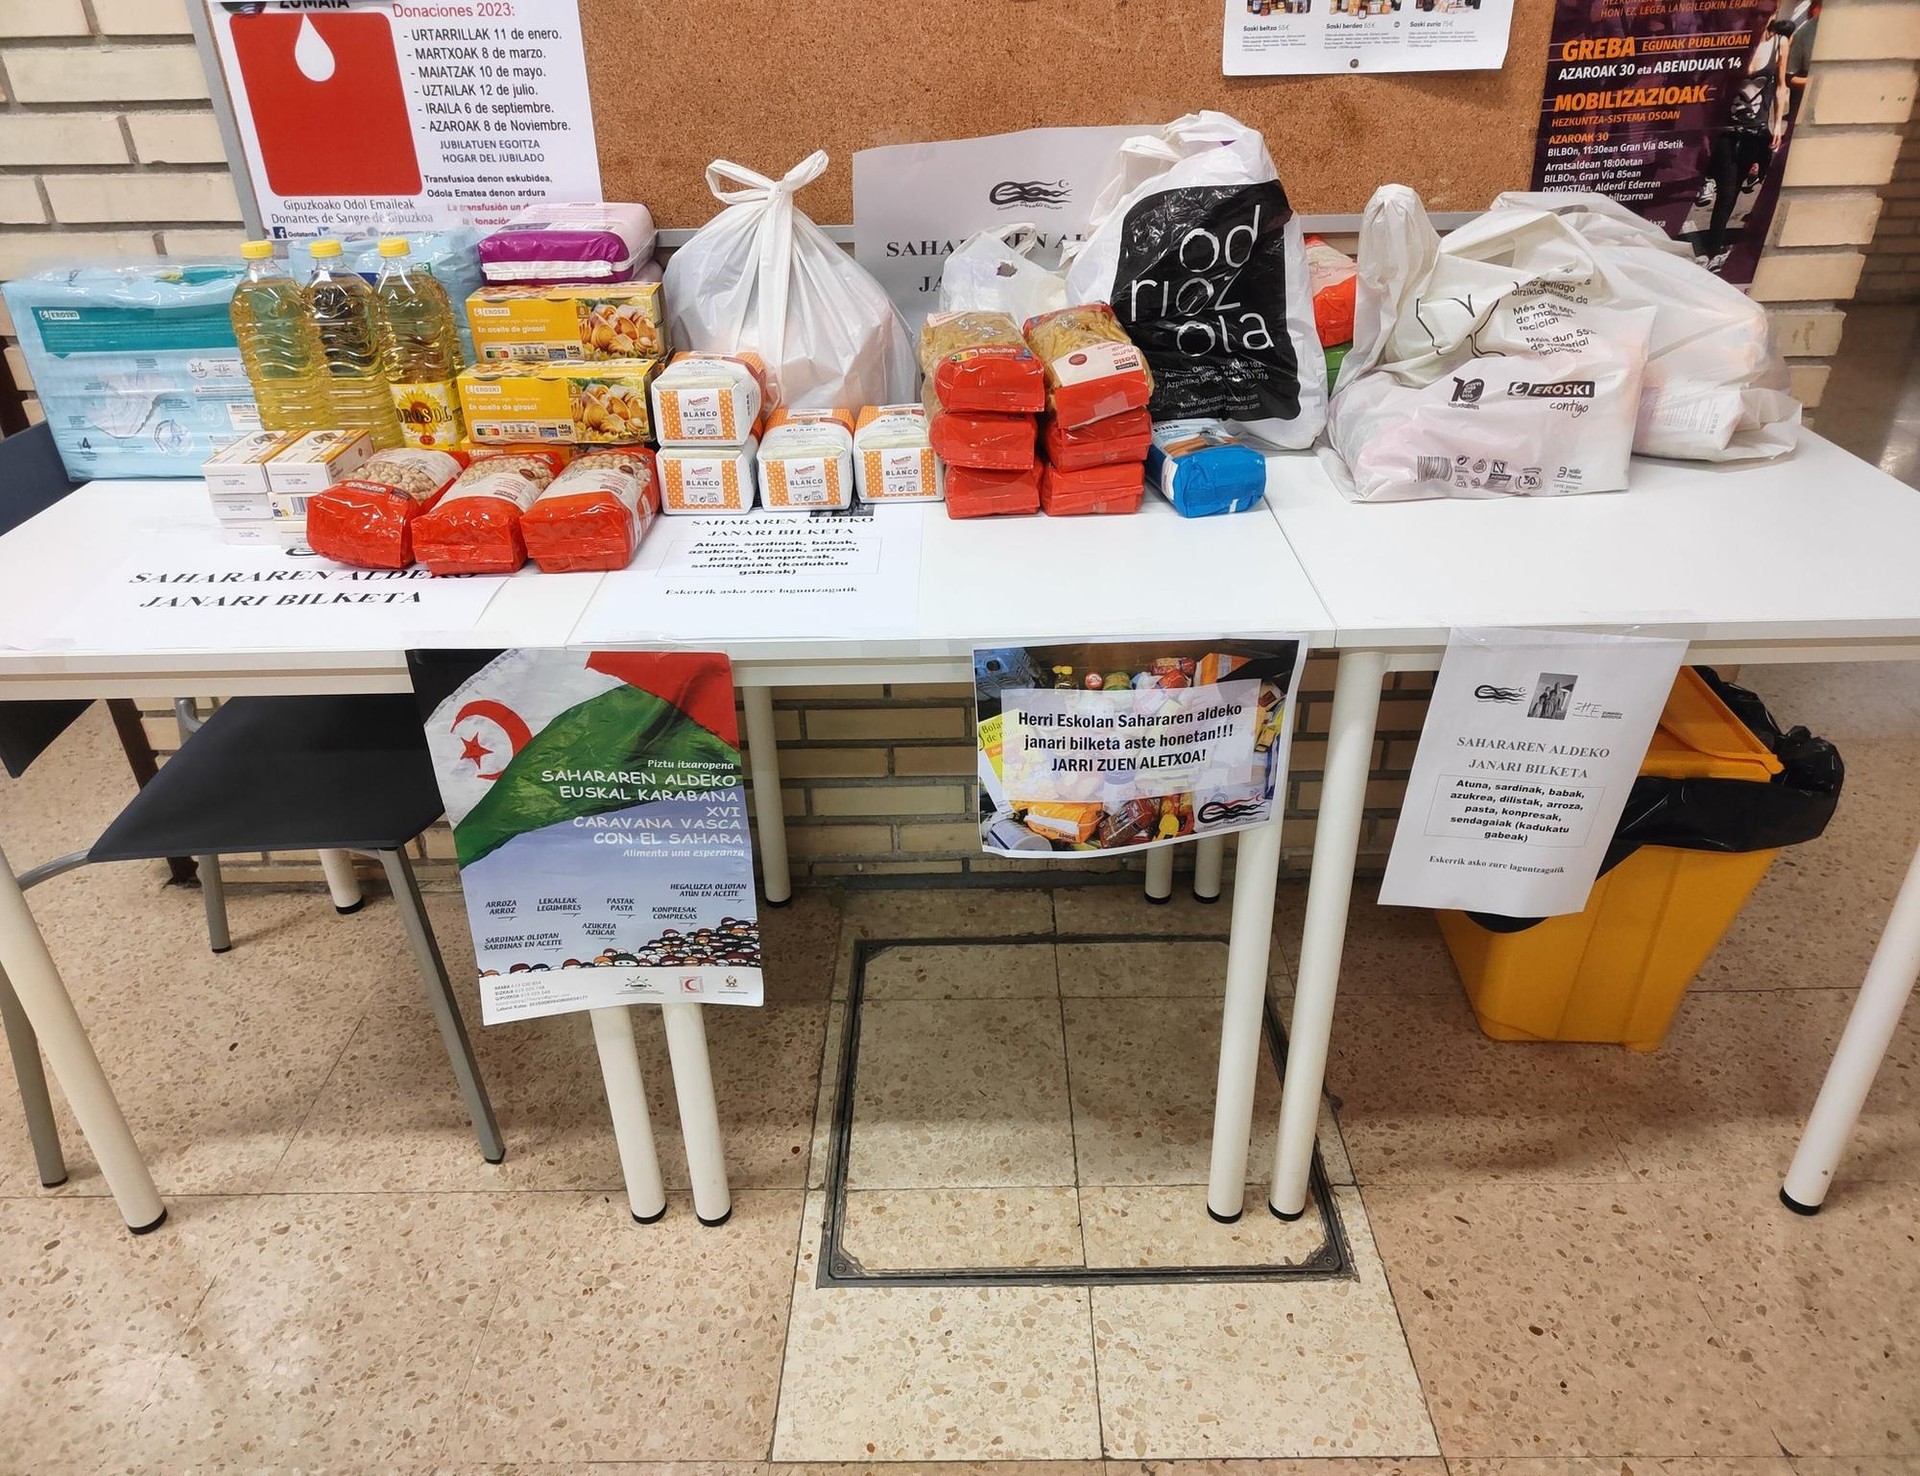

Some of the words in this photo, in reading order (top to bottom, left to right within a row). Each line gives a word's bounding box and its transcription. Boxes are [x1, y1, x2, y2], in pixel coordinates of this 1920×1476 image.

[393, 4, 474, 18] Donaciones
[477, 3, 515, 17] 2023:
[411, 28, 490, 41] URTARRILLAK
[494, 28, 507, 40] 11
[511, 28, 524, 40] de
[528, 30, 562, 40] enero.
[415, 47, 480, 60] MARTXOAK
[481, 47, 490, 59] 8
[492, 47, 506, 59] de
[509, 48, 546, 59] marzo.
[1562, 36, 1636, 62] GREBA
[1642, 38, 1685, 52] EGUNAK
[1688, 34, 1751, 50] PUBLIKOAN
[418, 66, 476, 78] MAIATZAK
[479, 66, 493, 78] 10
[496, 66, 510, 78] de
[513, 67, 546, 80] mayo.
[1558, 64, 1618, 80] AZAROAK
[1619, 63, 1635, 77] 30
[1637, 66, 1652, 76] eta
[1654, 58, 1724, 74] ABENDUAK
[1727, 56, 1742, 70] 14
[422, 84, 476, 97] UZTAILAK
[480, 84, 493, 96] 12
[496, 84, 510, 96] de
[512, 84, 538, 98] julio.
[1554, 85, 1710, 112] MOBILIZAZIOAK
[426, 103, 462, 114] IRAILA
[464, 102, 472, 114] 6
[475, 102, 488, 114] de
[492, 102, 554, 117] septiembre.
[1552, 112, 1646, 128] HEZKUNTZA-SISTEMA
[1648, 110, 1680, 122] OSOAN
[429, 120, 482, 132] AZAROAK
[484, 120, 491, 132] 8
[494, 120, 507, 132] de
[510, 120, 572, 132] Noviembre.
[440, 140, 498, 149] JUBILATUEN
[499, 140, 541, 149] EGOITZA
[1549, 134, 1595, 146] AZAROAK
[1596, 132, 1609, 143] 30
[1548, 145, 1581, 158] BILBOn,
[1583, 143, 1619, 156] 11:30ean
[1620, 142, 1641, 154] Gran
[1658, 140, 1684, 150] 85etik
[442, 154, 478, 163] HOGAR
[480, 154, 496, 162] DEL
[499, 153, 545, 162] JUBILADO
[1545, 160, 1601, 172] Arratsaldean
[1602, 157, 1644, 170] 18:00etan
[1579, 170, 1600, 182] Gran
[1616, 169, 1642, 178] 85ean
[1595, 180, 1626, 192] Alderdi
[1628, 179, 1661, 190] Ederren
[284, 200, 342, 212] Gipuzkoako
[344, 200, 368, 210] Odol
[522, 326, 546, 334] girasol
[1532, 383, 1590, 396] EROSKI
[513, 403, 537, 412] girasol
[1550, 400, 1588, 418] contigo
[886, 468, 918, 476] BLANCO
[790, 478, 824, 486] BLANCO
[691, 518, 797, 526] SAHARAREN
[778, 528, 854, 536] BILKETA
[128, 570, 333, 585] SAHARAREN
[139, 595, 273, 608] JANARI
[274, 591, 422, 606] BILKETA
[1018, 712, 1054, 726] Herri
[1057, 714, 1114, 729] Eskolan
[1118, 711, 1194, 728] Sahararen
[1197, 704, 1242, 721] aldeko
[1024, 734, 1066, 750] janari
[1070, 735, 1120, 751] bilketa
[1124, 736, 1156, 750] aste
[1160, 724, 1234, 748] honetan!!!
[1456, 736, 1546, 754] SAHARAREN
[1548, 745, 1610, 758] ALDEKO
[648, 760, 674, 769] Piztu
[678, 760, 734, 771] itxaropena
[1051, 758, 1094, 772] JARRI
[1096, 758, 1136, 772] ZUEN
[1140, 750, 1206, 770] ALETXOA!
[1468, 759, 1522, 772] JANARI
[1526, 764, 1588, 779] BILKETA
[541, 770, 656, 785] SAHARAREN
[664, 774, 736, 788] ALDEKO
[560, 785, 632, 800] EUSKAL
[638, 790, 738, 802] KARABANA
[1456, 780, 1492, 790] Atuna,
[1494, 782, 1546, 796] sardinak,
[1548, 788, 1585, 799] babak,
[1450, 792, 1496, 803] azukrea,
[1499, 795, 1544, 808] dilistak,
[1546, 800, 1584, 812] arroza,
[706, 806, 741, 818] XVI
[1464, 804, 1498, 816] pasta,
[1502, 807, 1562, 822] konpresak,
[572, 816, 673, 830] CARAVANA
[680, 818, 741, 830] VASCA
[1450, 815, 1512, 830] sendagaiak
[1514, 820, 1570, 834] (kadukatu
[594, 832, 632, 844] CON
[640, 832, 662, 845] EL
[668, 833, 743, 844] SAHARA
[1484, 830, 1528, 843] gabeak)
[623, 849, 668, 858] Alimenta
[671, 850, 690, 858] una
[692, 850, 744, 858] esperanza
[1429, 856, 1466, 866] Eskerrik
[1467, 858, 1487, 868] asko
[1488, 862, 1508, 870] zure
[1509, 863, 1566, 875] laguntzagatik
[679, 888, 700, 897] ATÚN
[485, 900, 517, 908] ARROZA
[538, 897, 578, 905] LEKALEAK
[489, 907, 516, 915] ARROZ
[537, 904, 582, 912] LEGUMBRES
[610, 904, 634, 912] PASTA
[652, 906, 698, 914] KONPRESAK
[652, 912, 698, 920] COMPRESAS
[582, 922, 617, 930] AZUKREA
[585, 928, 616, 936] AZÚCAR
[485, 935, 525, 944] SARDINAK
[527, 932, 560, 940] OLIOTAN
[484, 942, 522, 951] SARDINAS
[537, 939, 562, 947] ACEITE
